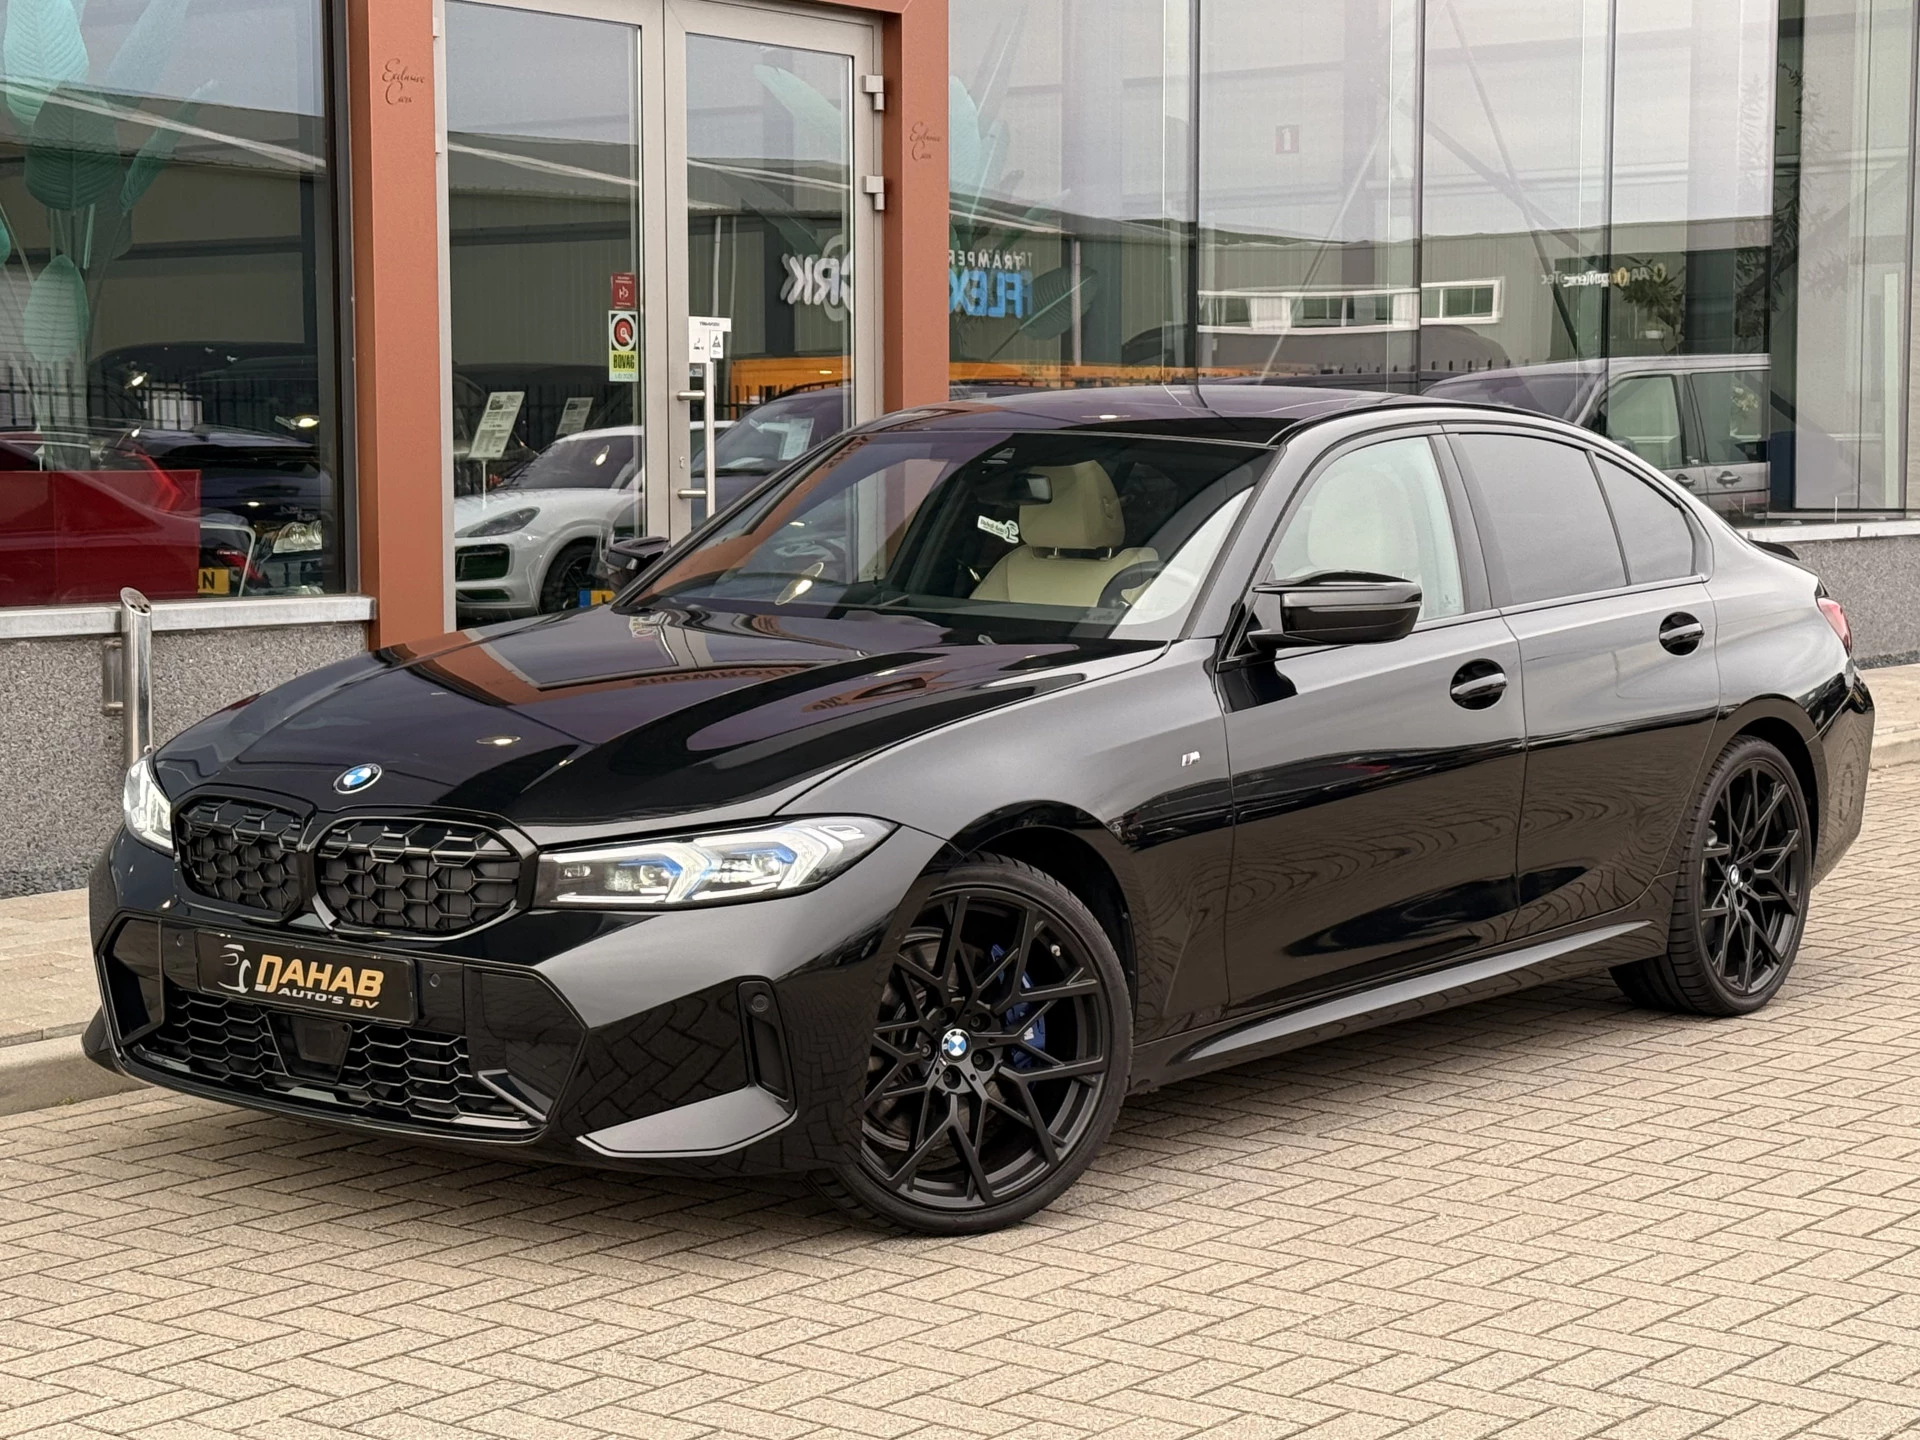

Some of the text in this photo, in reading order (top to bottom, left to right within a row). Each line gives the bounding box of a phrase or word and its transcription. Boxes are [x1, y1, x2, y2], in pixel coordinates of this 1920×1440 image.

[613, 354, 635, 369] BOVAG
[254, 953, 384, 998] DAHAB
[277, 987, 380, 1009] AUTO'S BV
